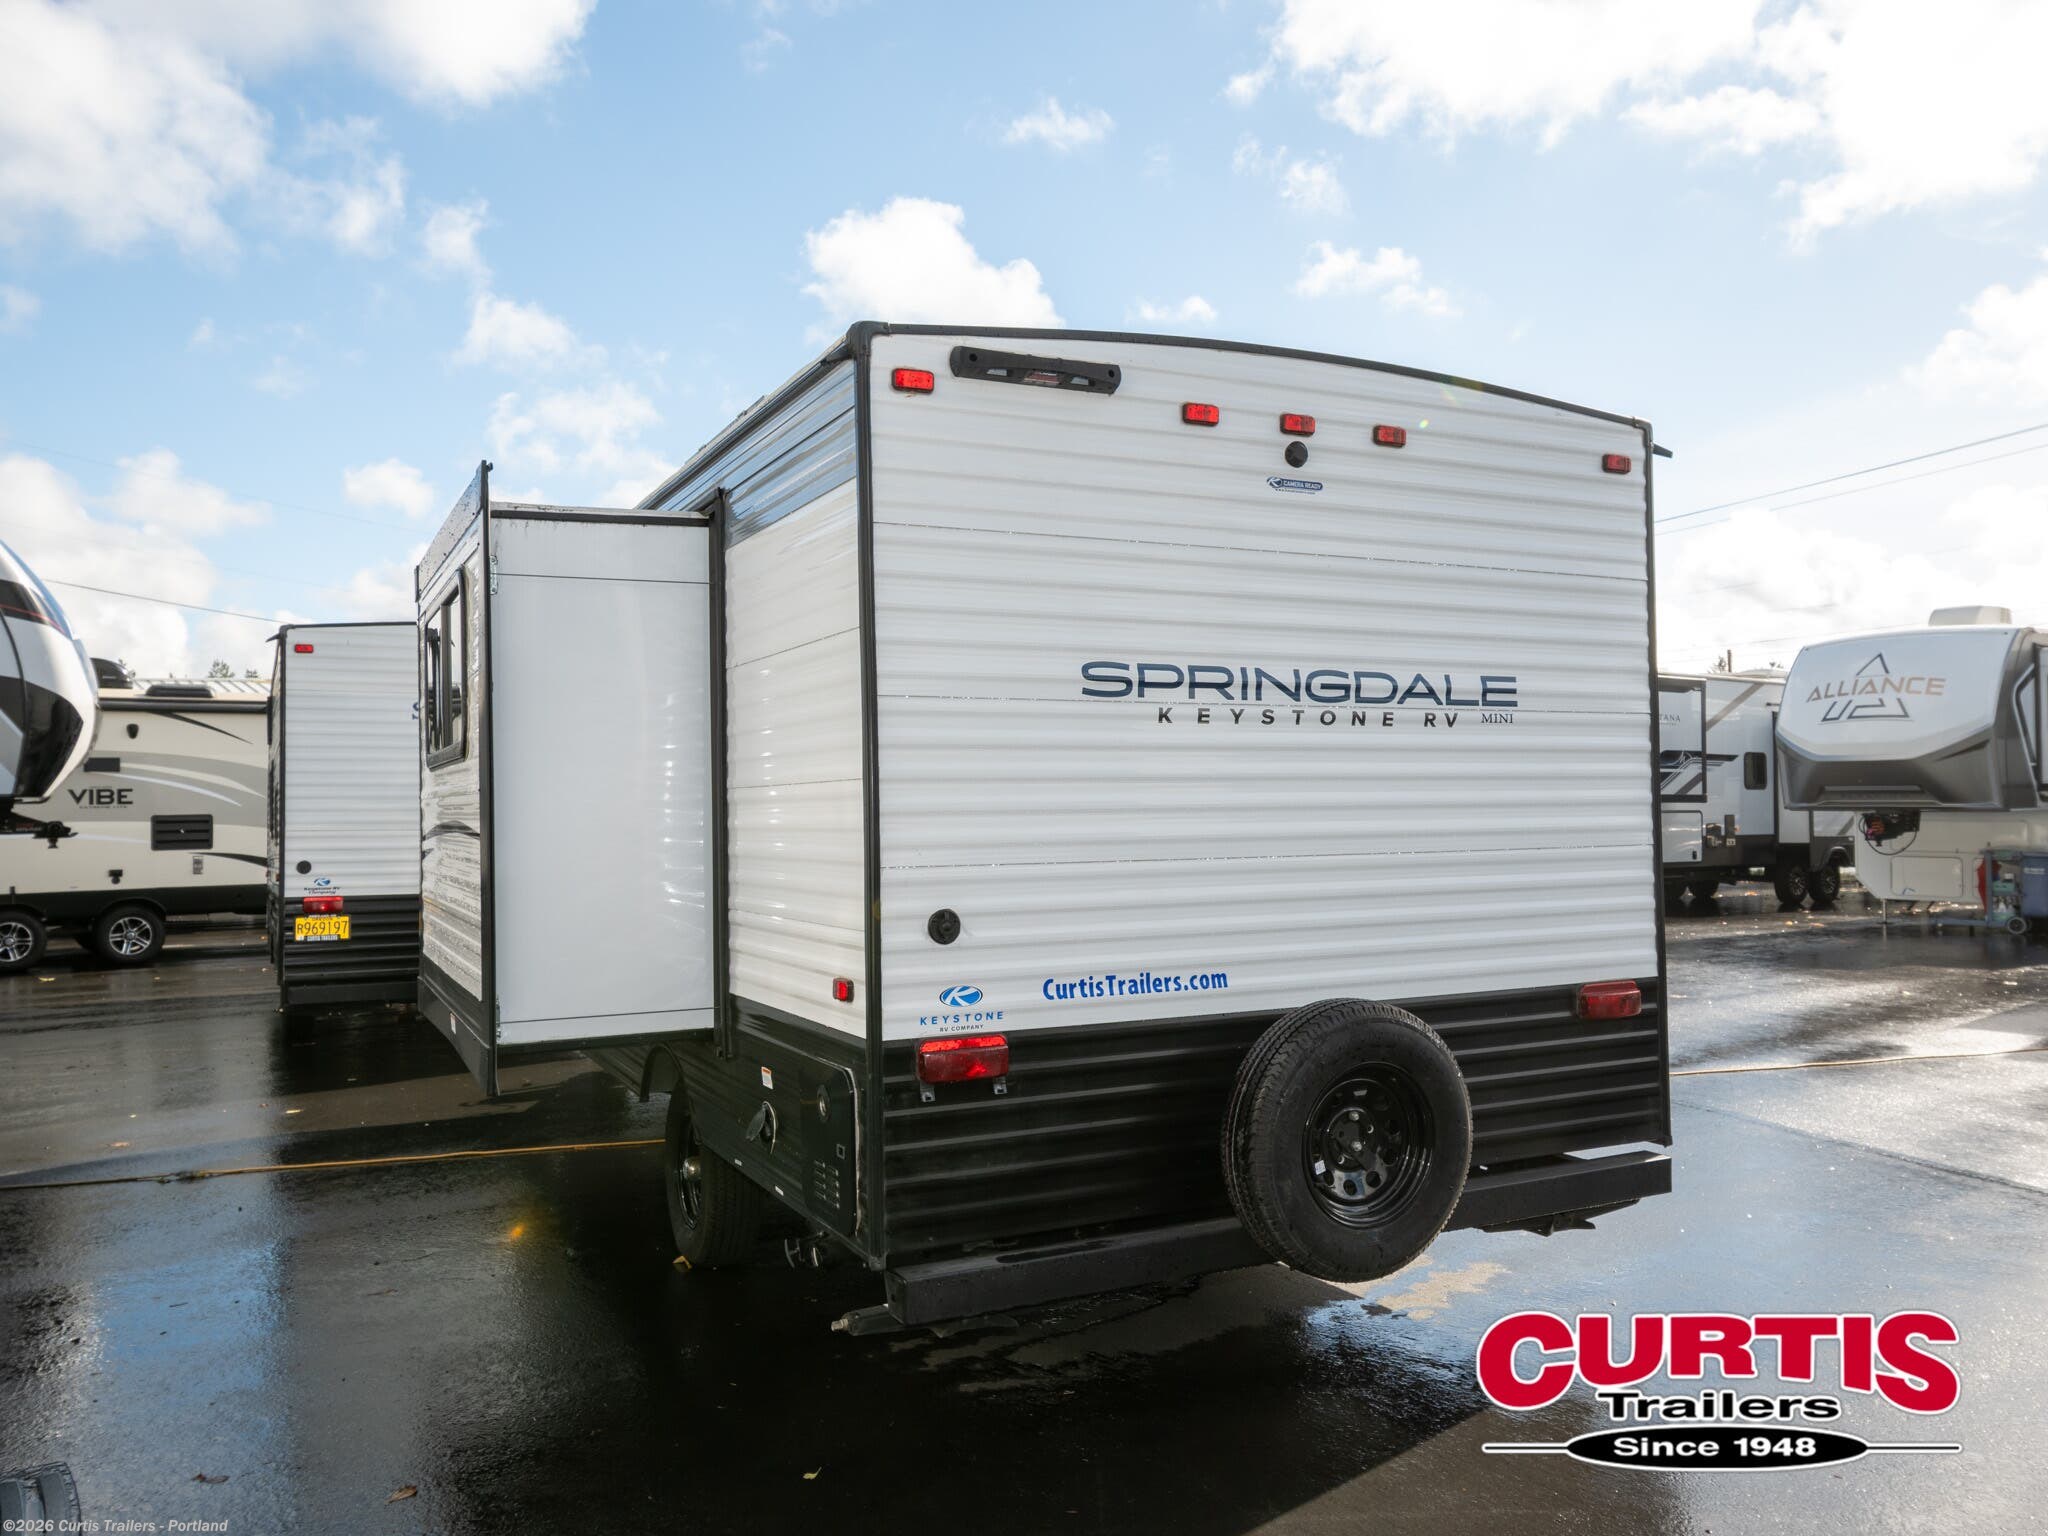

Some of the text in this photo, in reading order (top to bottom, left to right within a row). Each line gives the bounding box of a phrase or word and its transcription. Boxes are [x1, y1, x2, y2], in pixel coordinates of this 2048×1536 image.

[1081, 661, 1518, 707] SPRINGDALE
[1806, 676, 1946, 703] ALLIANCE
[1158, 707, 1513, 728] KEYSTONE RV MINI
[67, 788, 133, 805] VIBE
[297, 920, 348, 936] R969197
[1042, 972, 1229, 1001] CurtisTrailers.com
[920, 1011, 1004, 1026] KEYSTONE
